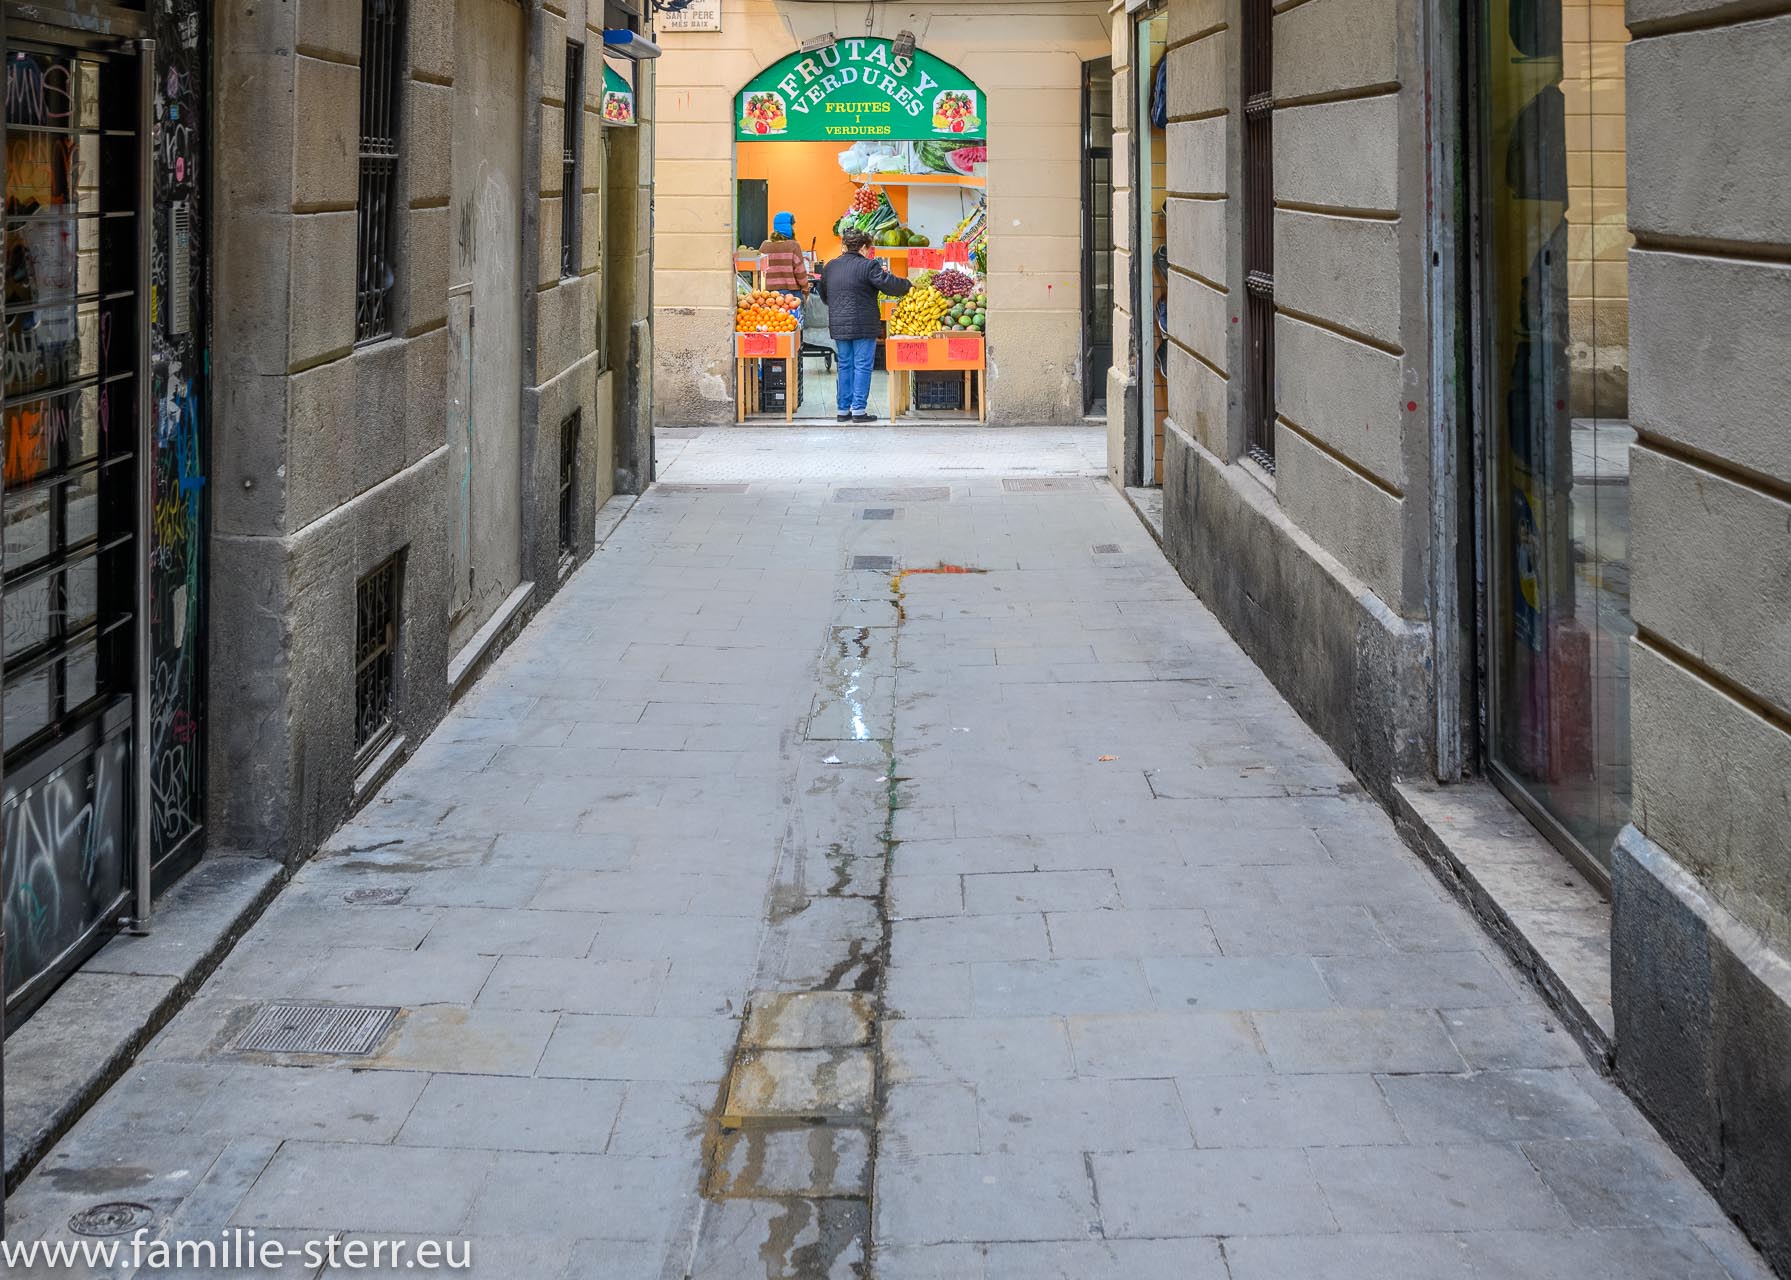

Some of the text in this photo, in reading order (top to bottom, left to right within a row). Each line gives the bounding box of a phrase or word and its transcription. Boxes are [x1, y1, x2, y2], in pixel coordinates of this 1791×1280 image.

[665, 11, 714, 20] SANT PERE
[777, 39, 938, 100] FRUTAS Y
[791, 66, 925, 117] VERDURES
[825, 102, 891, 113] FRUITES
[855, 114, 860, 123] I
[825, 125, 891, 135] VERDURES
